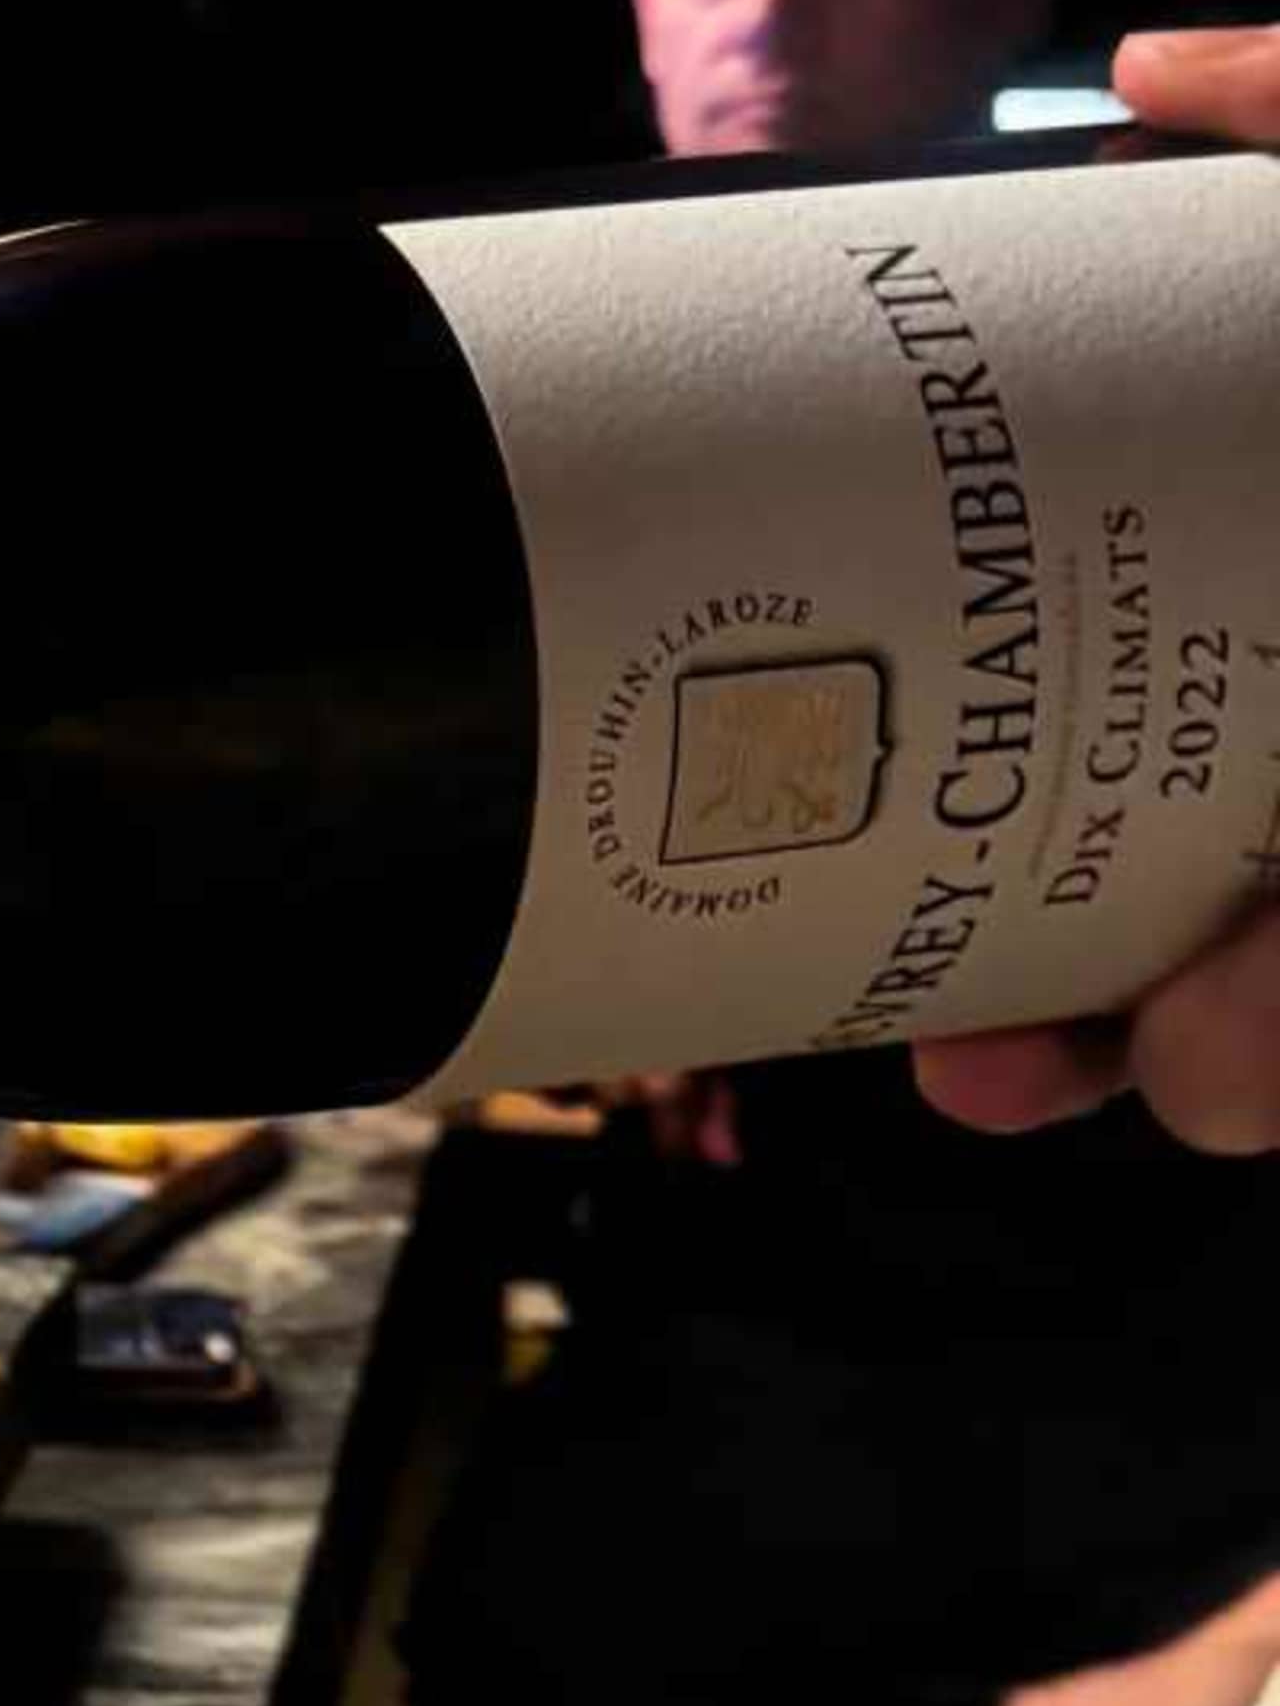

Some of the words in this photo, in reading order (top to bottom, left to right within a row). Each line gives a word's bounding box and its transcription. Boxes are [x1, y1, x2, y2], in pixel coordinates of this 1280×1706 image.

[1043, 807, 1126, 907] DIX
[1086, 505, 1149, 784] CLIMATS
[1158, 626, 1230, 799] 2022
[610, 863, 781, 918] DOMAINE
